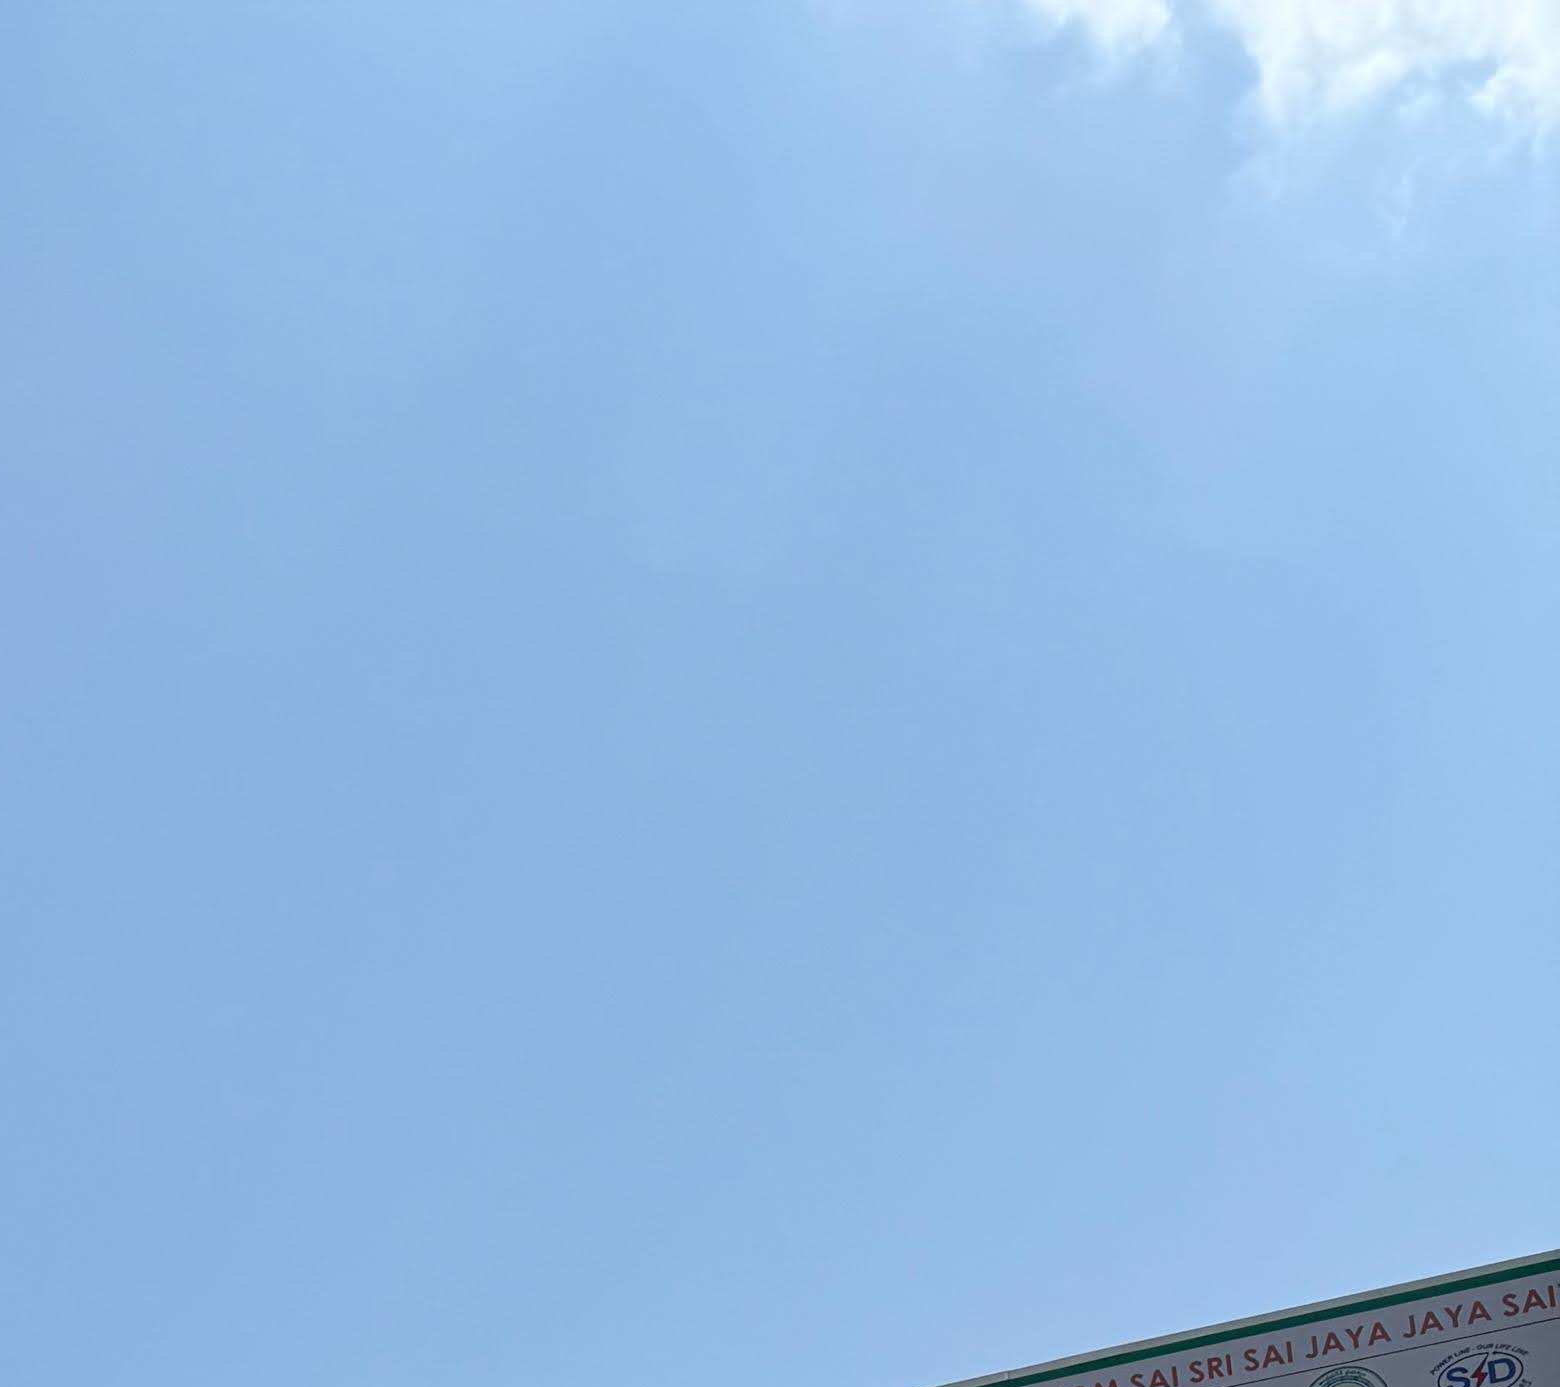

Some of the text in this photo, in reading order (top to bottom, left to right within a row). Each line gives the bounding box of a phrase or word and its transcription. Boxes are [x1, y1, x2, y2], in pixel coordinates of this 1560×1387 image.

[1188, 1353, 1232, 1383] SRI
[1243, 1340, 1293, 1371] SAI
[1305, 1321, 1391, 1358] JAYA
[1403, 1300, 1492, 1338] JAYA
[1502, 1281, 1560, 1317] SAI
